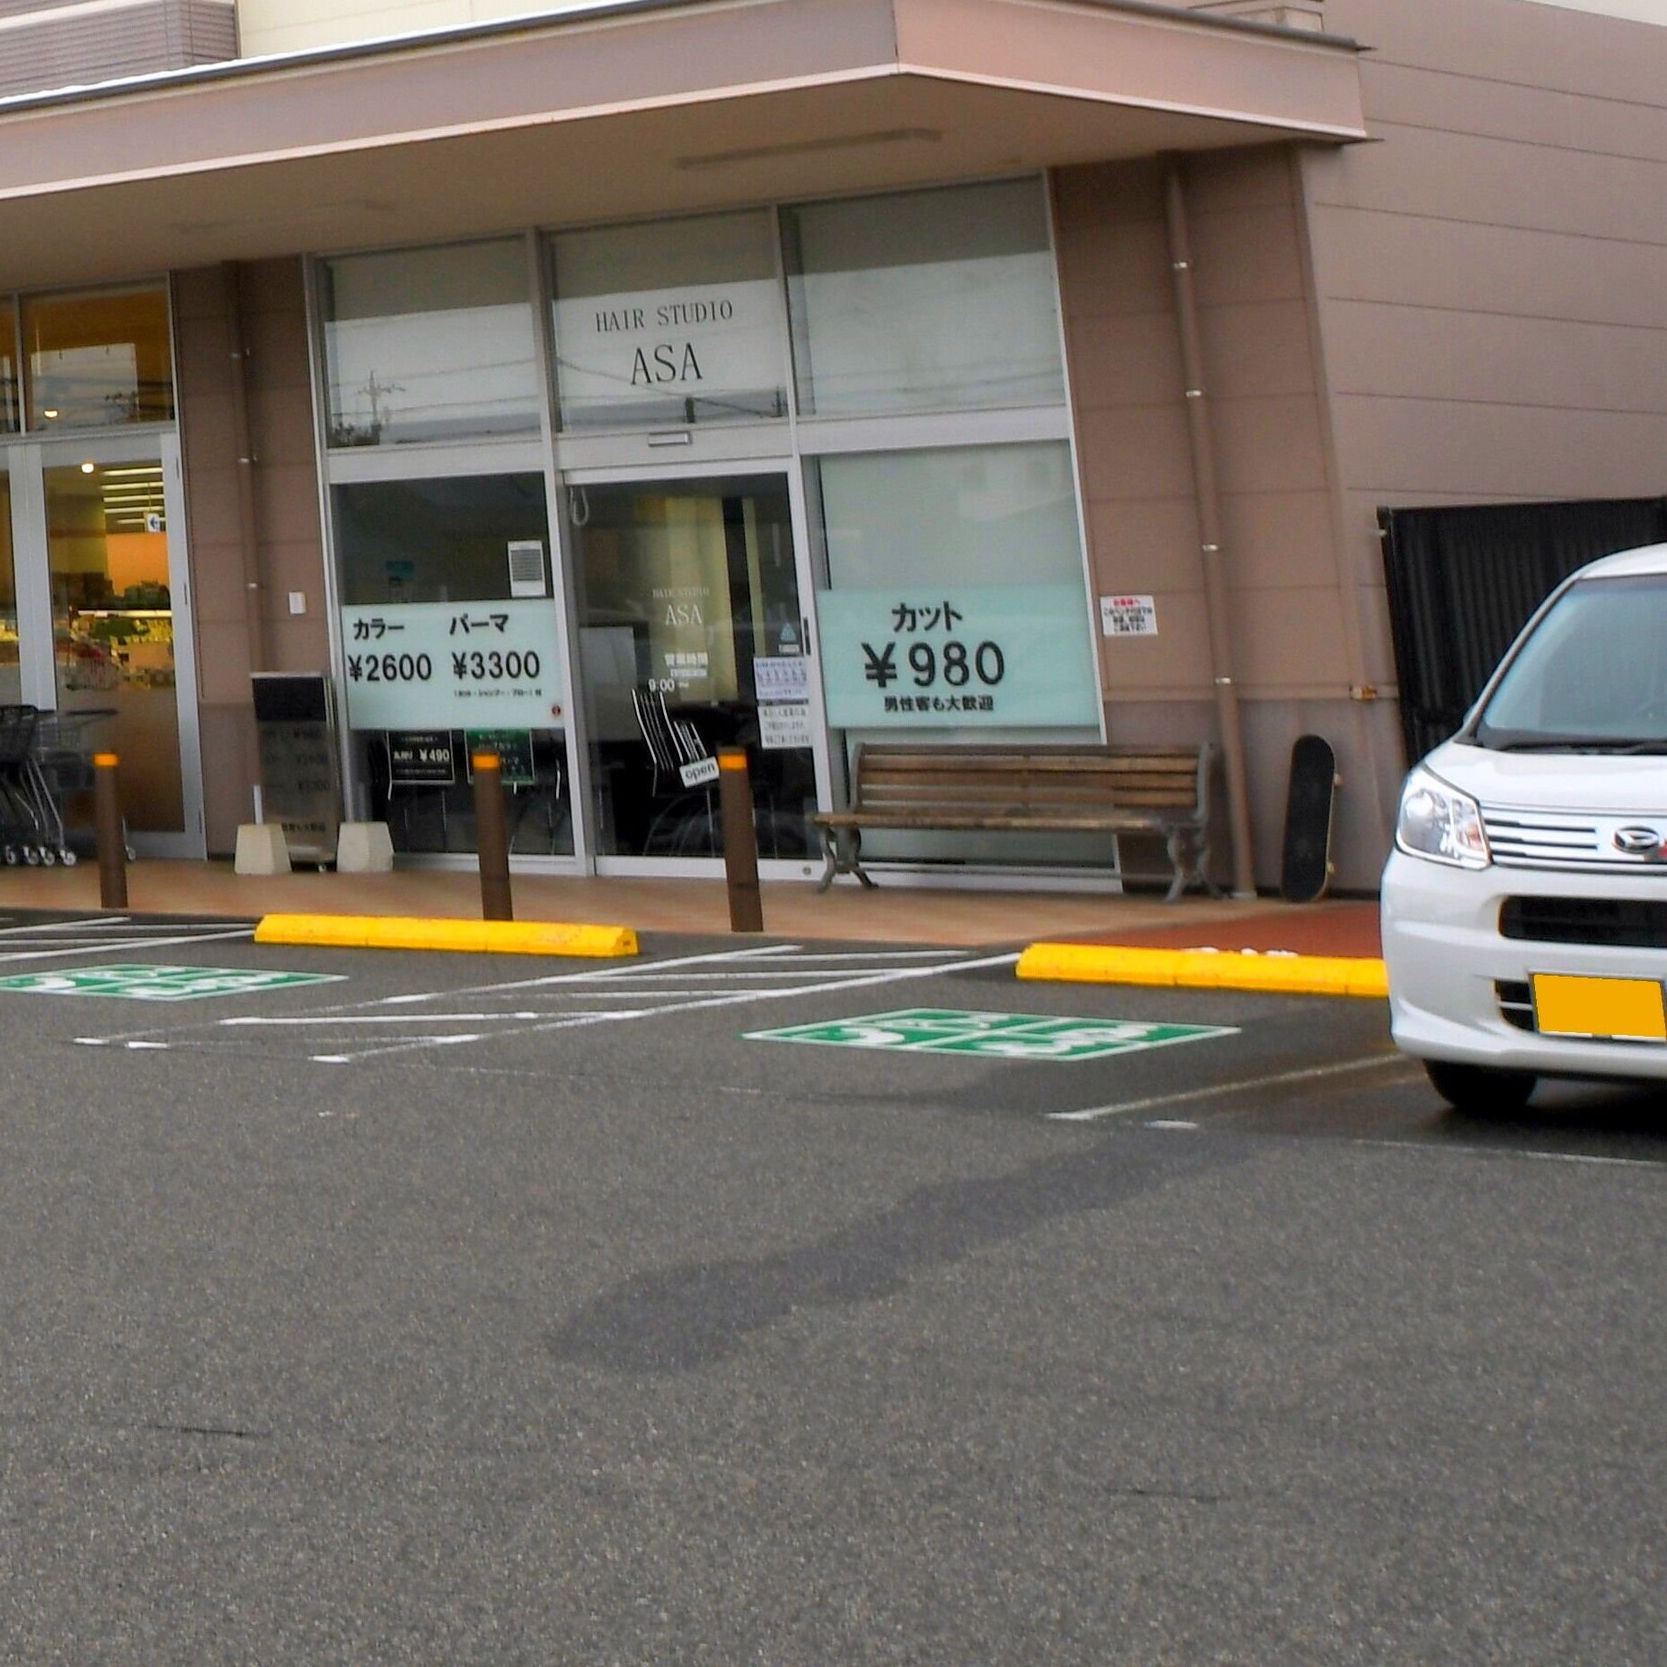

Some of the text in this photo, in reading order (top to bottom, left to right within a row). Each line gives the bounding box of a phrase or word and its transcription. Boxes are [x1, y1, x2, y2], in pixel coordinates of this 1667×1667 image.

[596, 299, 733, 332] HAIR STUDIO
[631, 342, 703, 385] ASA
[353, 618, 405, 640] カラー
[665, 603, 703, 626] ASA
[892, 601, 963, 633] カット
[348, 653, 432, 682] ¥2600
[451, 650, 540, 680] ¥3300
[861, 640, 1005, 688] ¥980
[684, 762, 717, 783] open
